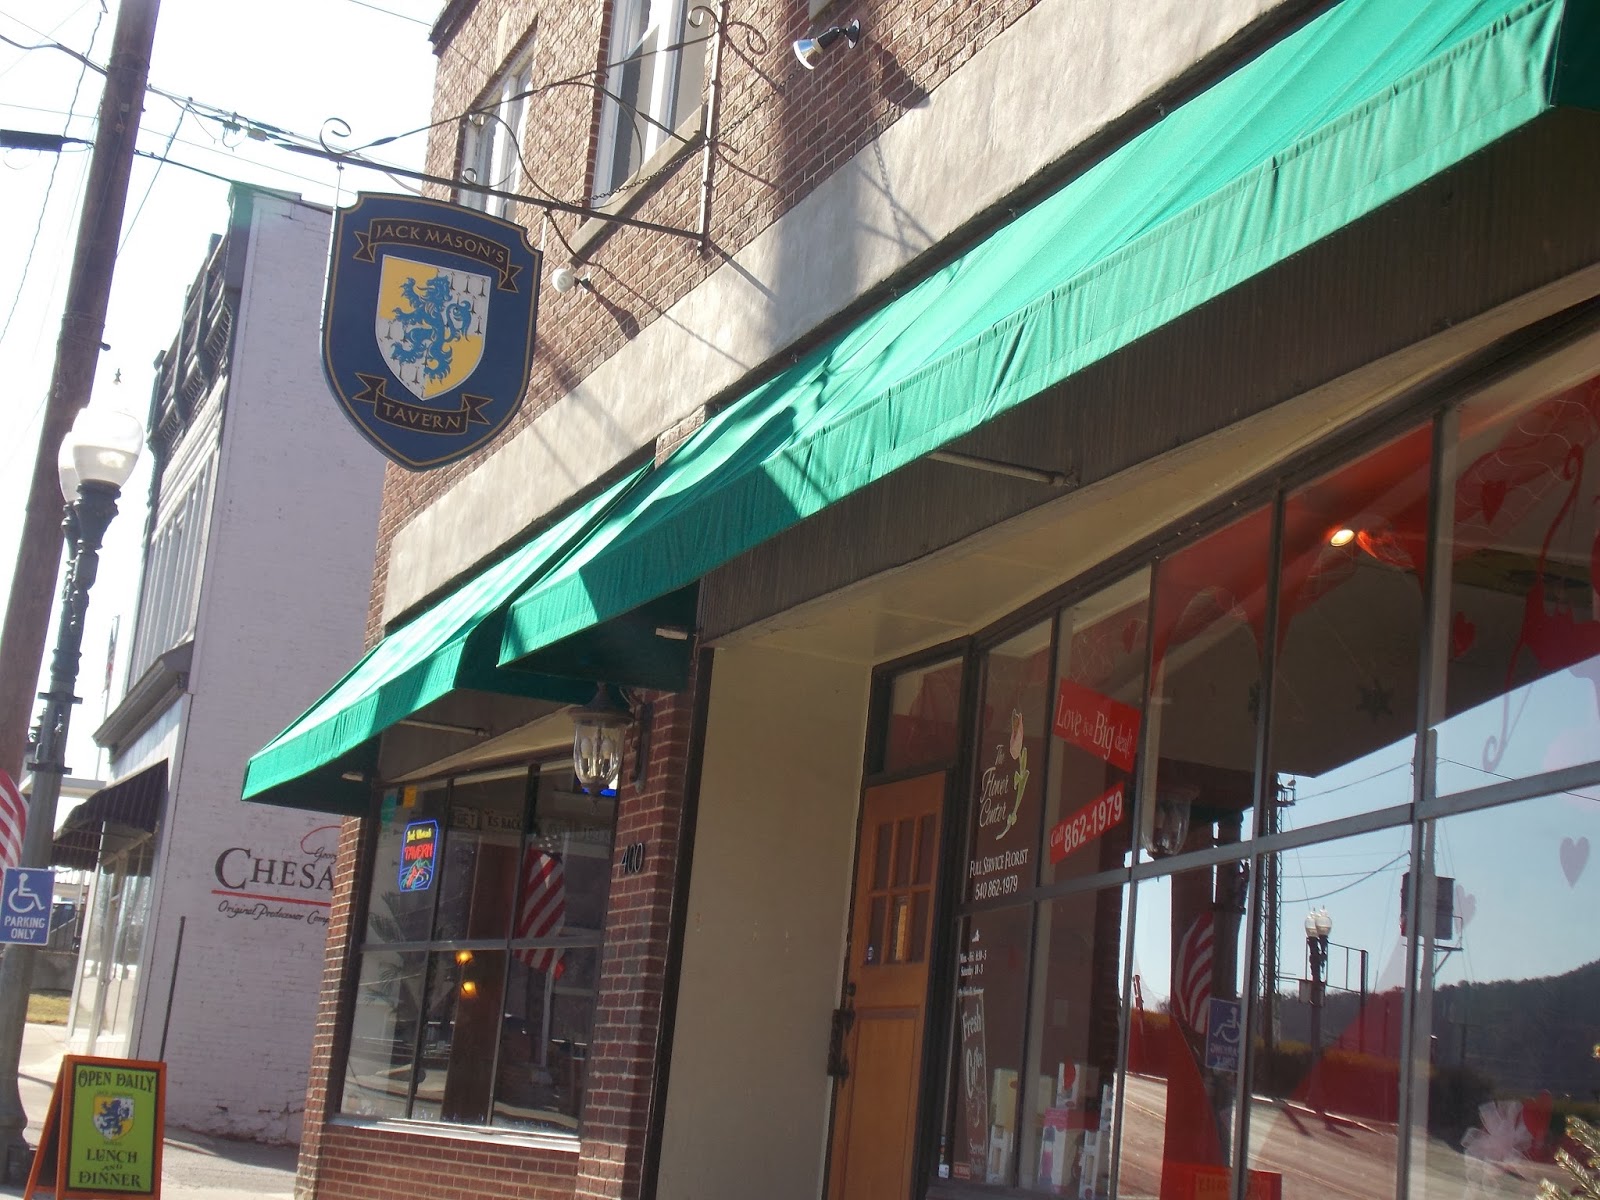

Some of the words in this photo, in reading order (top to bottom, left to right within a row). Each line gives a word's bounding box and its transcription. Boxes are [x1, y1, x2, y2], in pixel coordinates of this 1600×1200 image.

[375, 224, 420, 240] JACK
[425, 228, 505, 263] MASON'S
[382, 402, 461, 429] TAVERN
[1056, 694, 1082, 737] Love
[1093, 710, 1115, 761] Big
[979, 766, 1009, 804] Flower
[979, 797, 1007, 828] Center
[1064, 790, 1123, 853] 862-1979
[404, 843, 433, 861] TAVERN
[621, 842, 643, 875] 400
[969, 859, 983, 879] FULL
[983, 853, 1005, 874] SERVICE
[1005, 848, 1029, 870] FLORIST
[214, 847, 335, 891] CHESA
[974, 881, 988, 901] 540
[987, 874, 1018, 897] 862-1979
[4, 915, 46, 929] PARKING
[217, 899, 256, 919] Original
[10, 927, 36, 940] ONLY
[962, 1003, 982, 1041] Fresh
[78, 1069, 112, 1088] OPEN
[116, 1073, 155, 1093] DAILY
[86, 1148, 138, 1163] LUNCH
[102, 1163, 123, 1171] AND
[78, 1171, 142, 1189] DINNER
